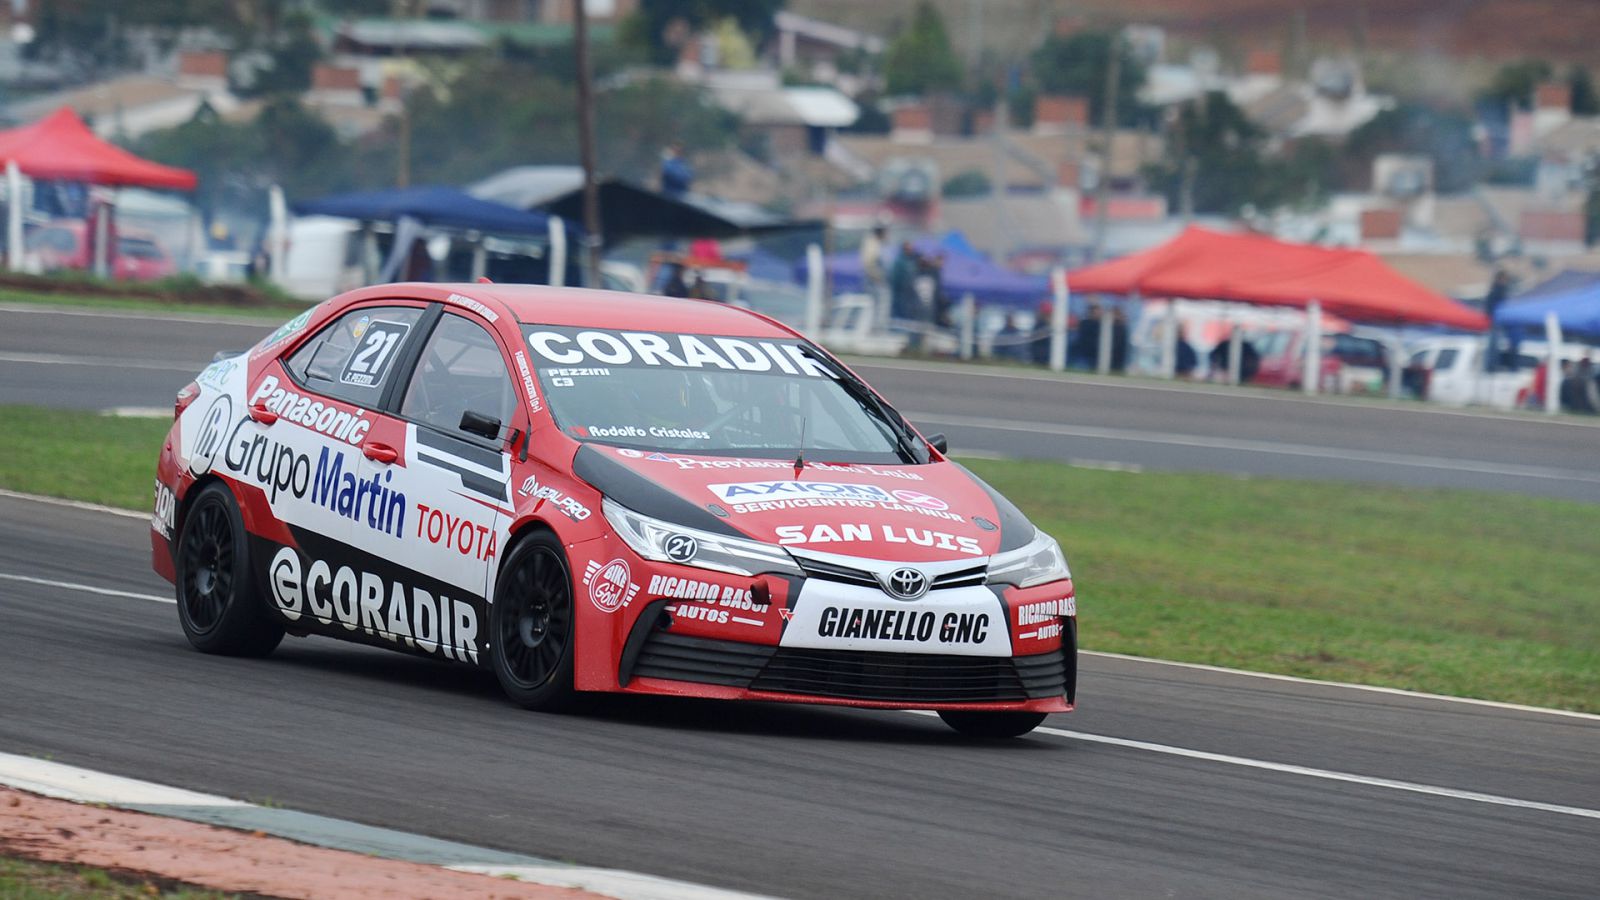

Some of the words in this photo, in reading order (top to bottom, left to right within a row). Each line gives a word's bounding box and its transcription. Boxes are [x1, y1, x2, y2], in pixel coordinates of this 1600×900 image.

[350, 330, 400, 374] 21
[528, 331, 841, 379] CORADIR
[548, 368, 610, 376] PEZZINI
[552, 378, 575, 387] C3
[249, 375, 370, 445] Panasonic
[588, 425, 646, 437] Rodolfo
[649, 426, 710, 440] Cristales
[671, 457, 811, 470] Previsor
[225, 415, 311, 505] Grupo
[311, 445, 406, 539] Martin
[724, 481, 886, 498] AXION
[734, 498, 876, 514] SERVICENTRO
[880, 502, 965, 523] LAFINUR
[416, 503, 496, 562] TOYOTA
[775, 524, 873, 544] SAN
[882, 525, 983, 555] LUIS
[669, 538, 694, 556] 21
[603, 564, 627, 589] BIKE
[648, 575, 720, 604] RICARDO
[306, 560, 479, 665] CORADIR
[677, 605, 729, 624] AUTOS
[1019, 600, 1058, 626] RICARDO
[818, 607, 935, 642] GIANELLO
[939, 612, 989, 644] GNC
[1037, 624, 1059, 640] AUTOS
